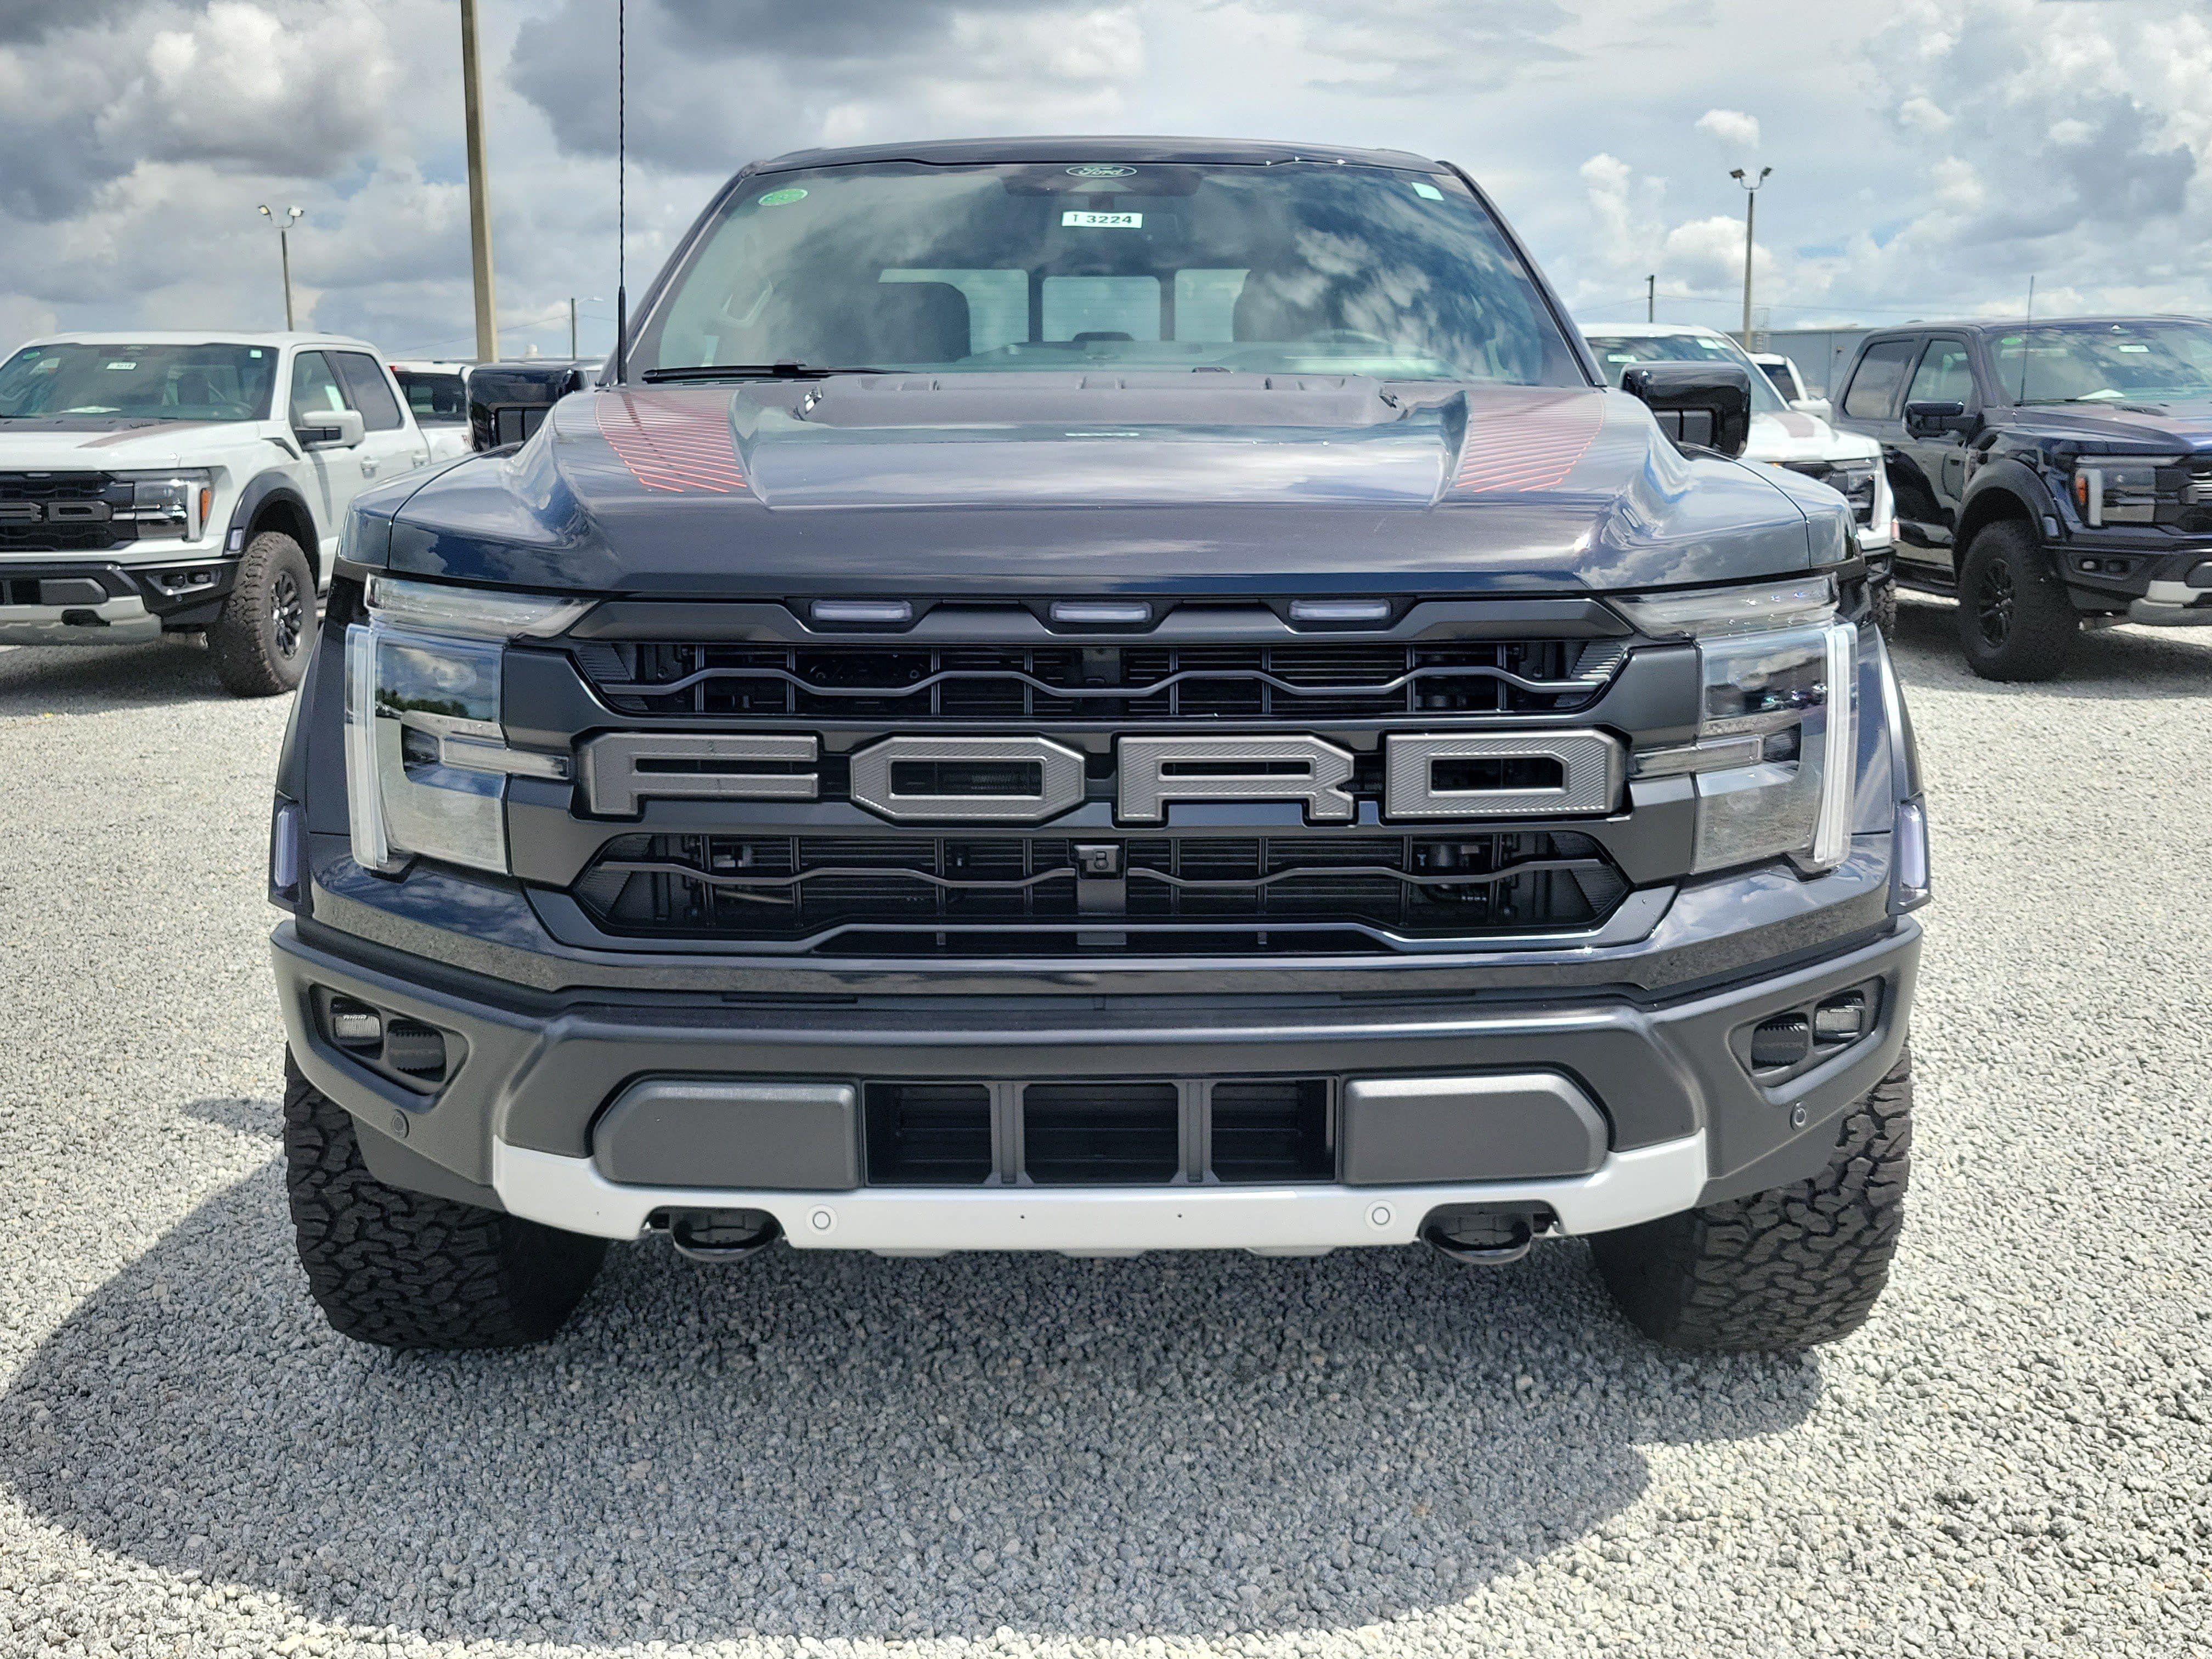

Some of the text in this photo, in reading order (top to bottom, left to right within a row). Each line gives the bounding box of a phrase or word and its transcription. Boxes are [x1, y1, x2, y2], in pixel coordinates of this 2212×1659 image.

[1078, 166, 1124, 176] Ford
[1086, 215, 1132, 224] 3224
[579, 730, 1624, 822] FORD
